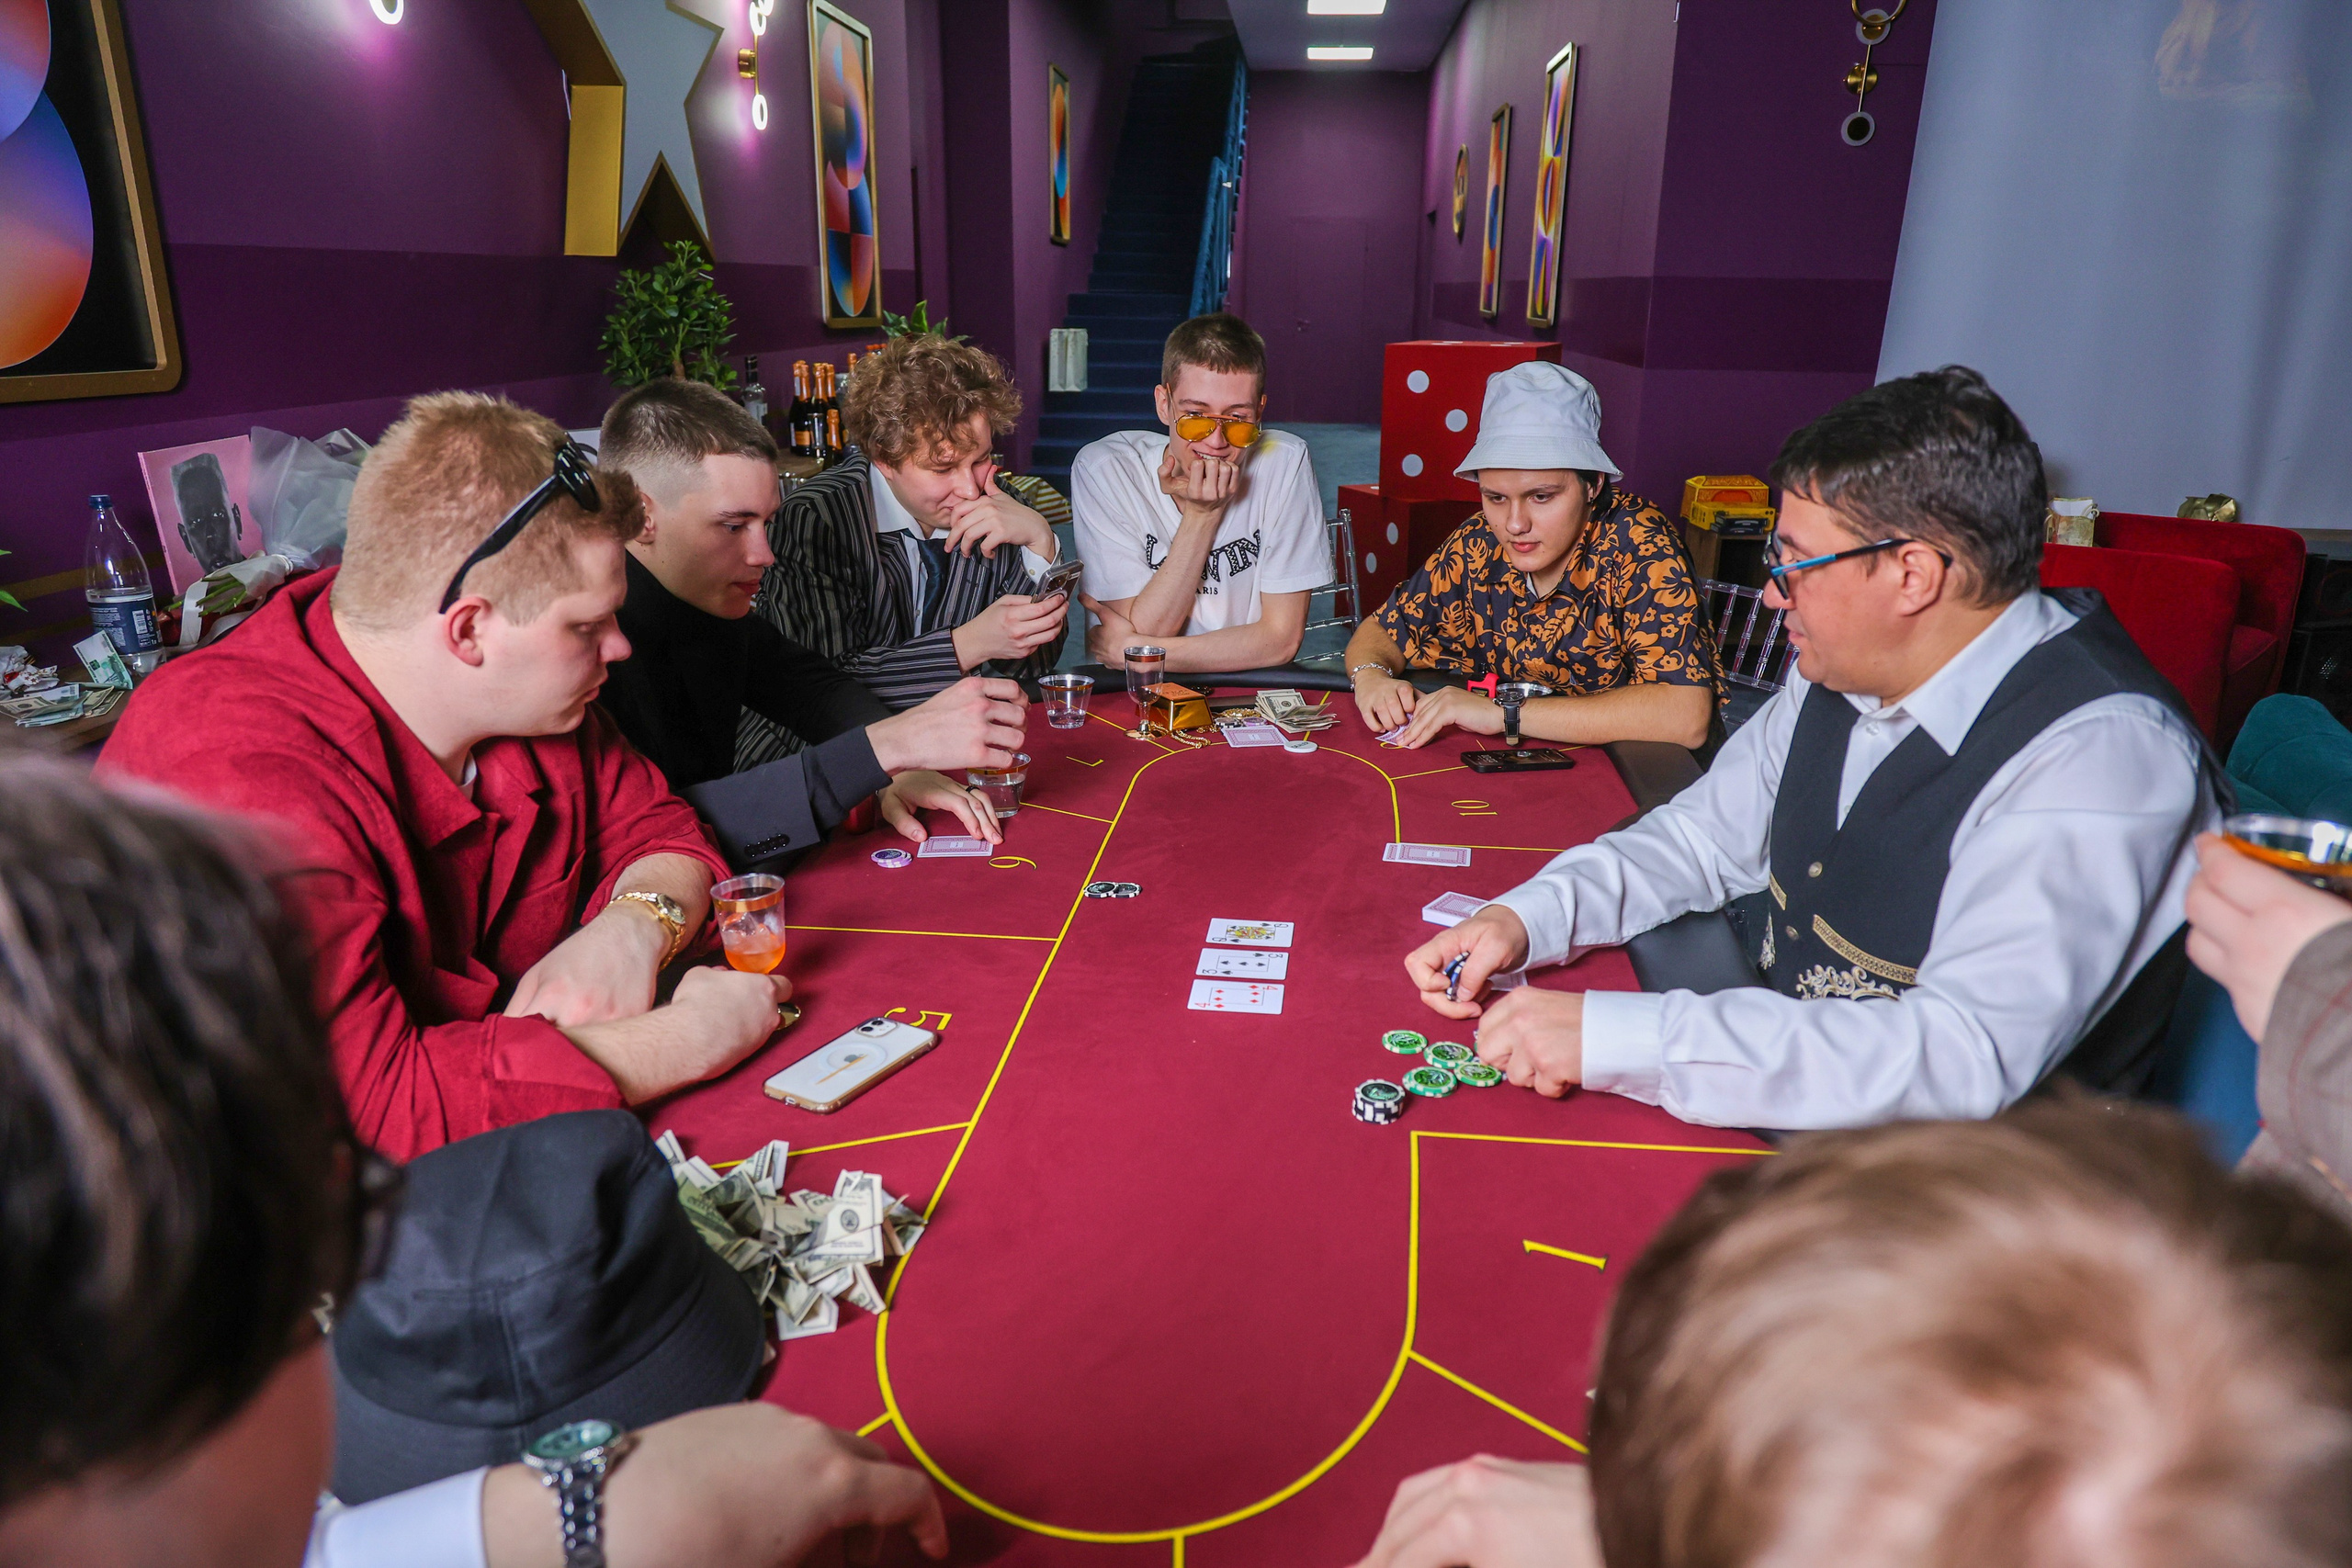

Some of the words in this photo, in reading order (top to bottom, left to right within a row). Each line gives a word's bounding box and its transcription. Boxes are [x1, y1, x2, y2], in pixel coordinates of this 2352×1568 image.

[1146, 529, 1261, 582] LVIN
[1195, 586, 1218, 595] ARIS
[1452, 799, 1498, 817] 10
